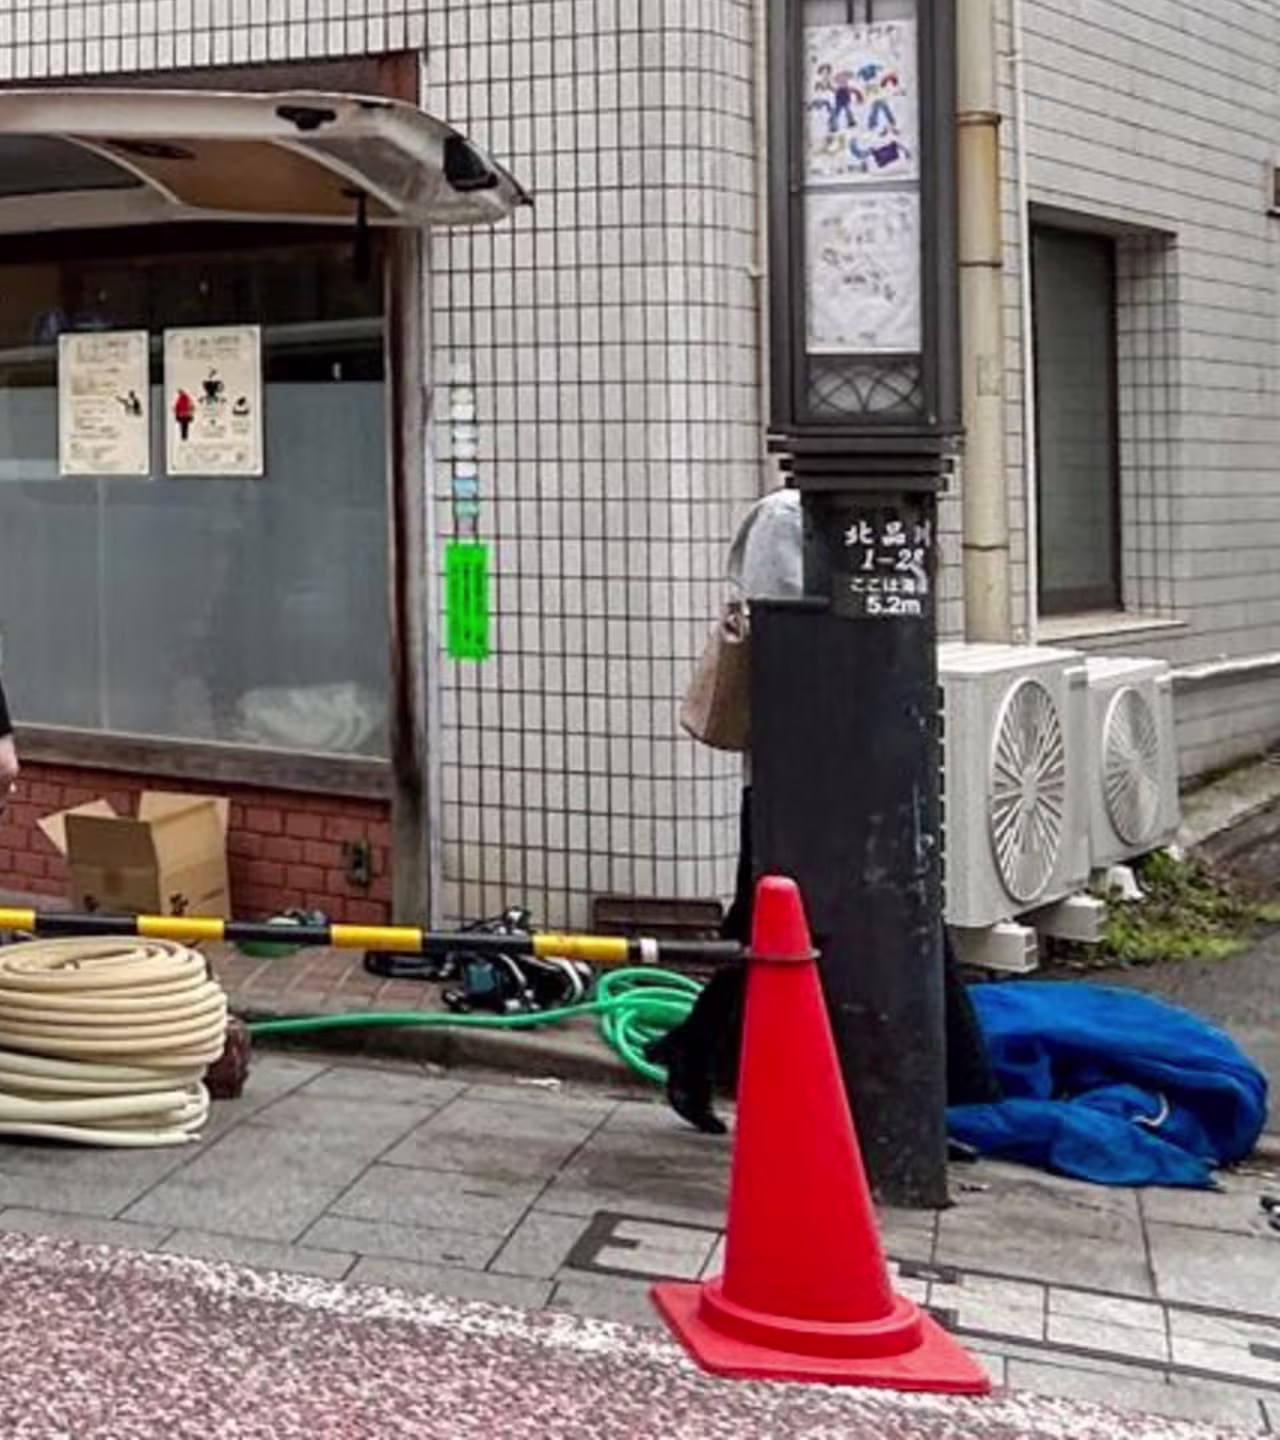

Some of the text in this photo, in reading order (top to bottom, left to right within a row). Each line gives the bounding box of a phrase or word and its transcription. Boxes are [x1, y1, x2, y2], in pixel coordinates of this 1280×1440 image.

[844, 520, 931, 547] 北品川
[866, 596, 922, 615] 5.2m
